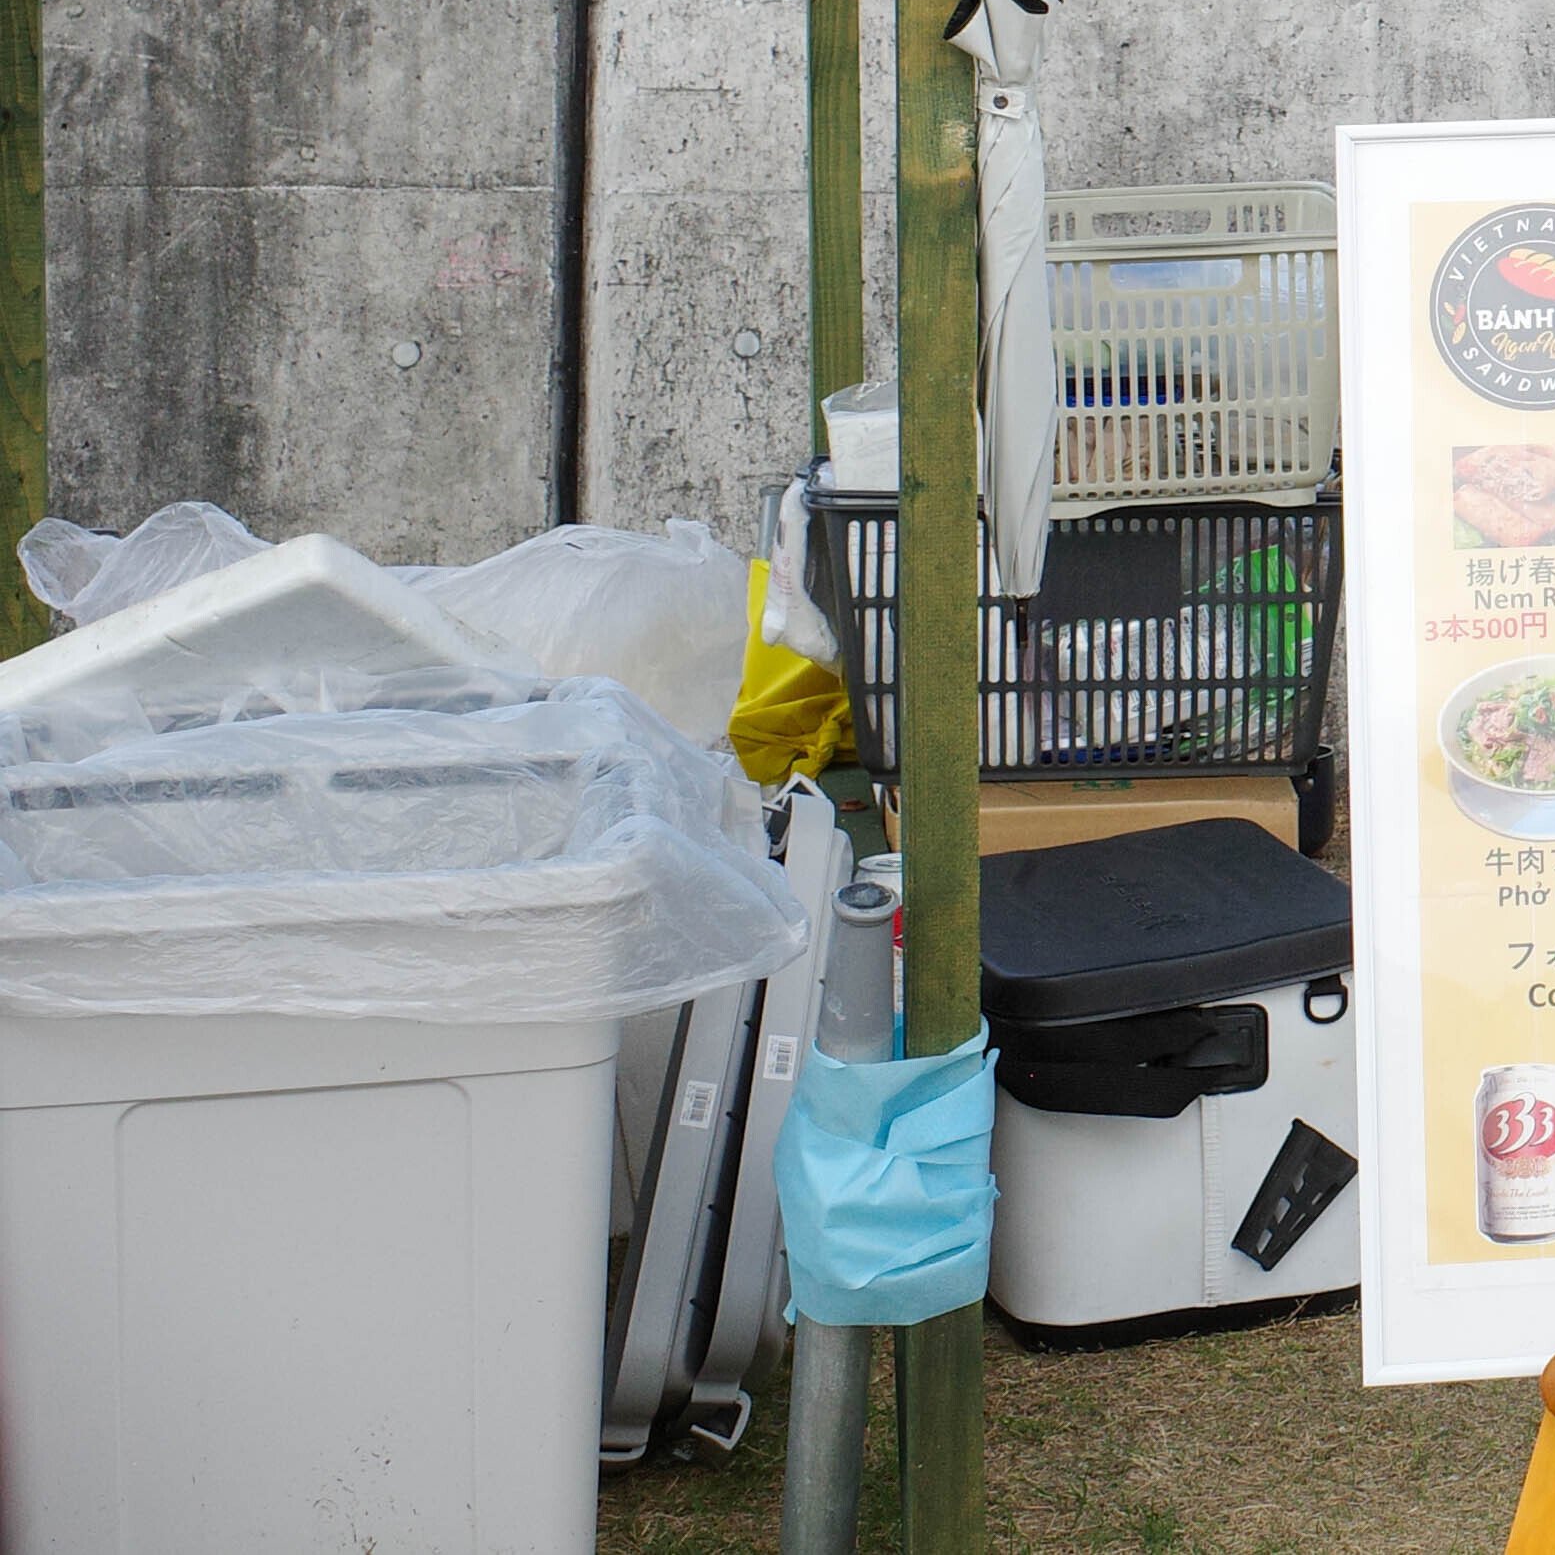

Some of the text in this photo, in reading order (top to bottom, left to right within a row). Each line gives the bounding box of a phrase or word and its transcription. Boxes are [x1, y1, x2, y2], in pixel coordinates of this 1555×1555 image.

[1476, 304, 1555, 330] BÁNH
[1474, 589, 1533, 610] Nem
[1424, 612, 1548, 643] 3本500円
[1499, 881, 1550, 906] Phở
[1488, 1092, 1554, 1156] 333
